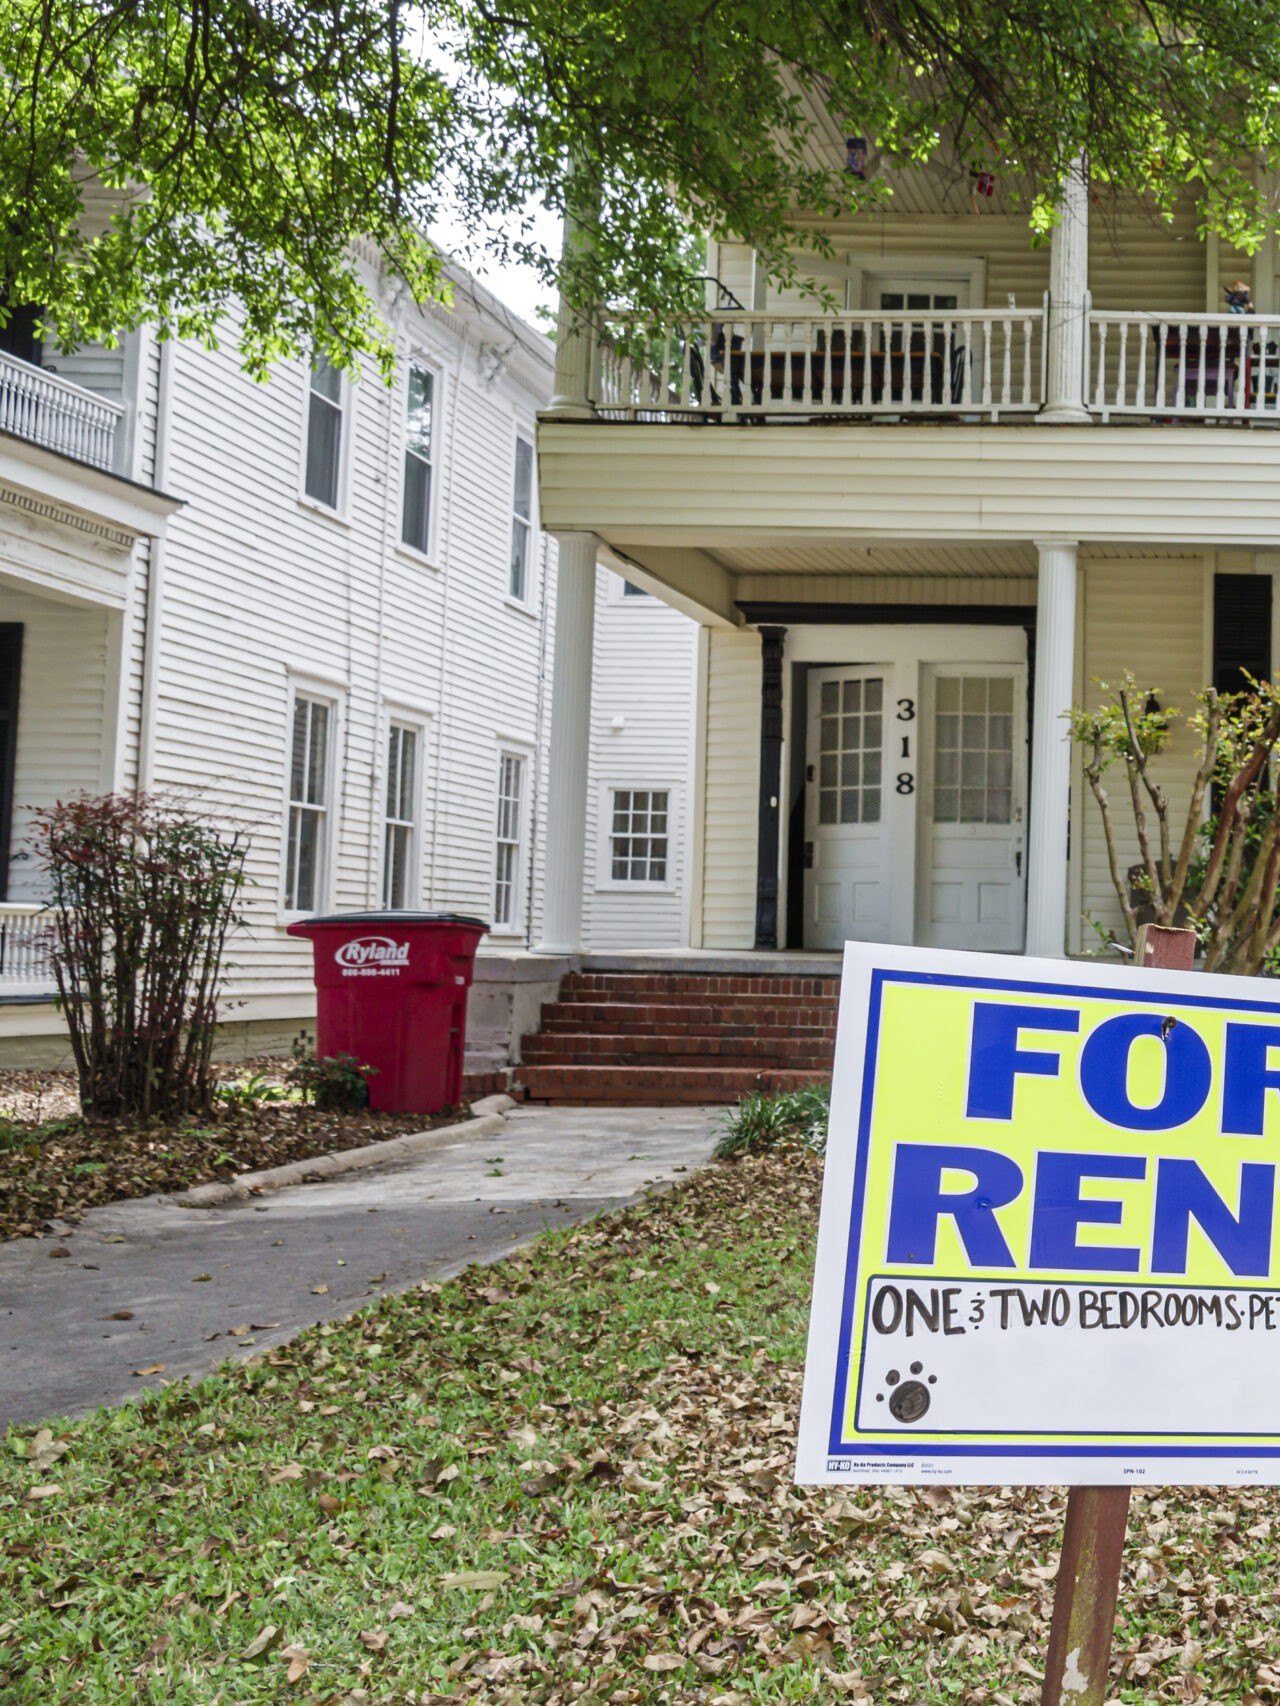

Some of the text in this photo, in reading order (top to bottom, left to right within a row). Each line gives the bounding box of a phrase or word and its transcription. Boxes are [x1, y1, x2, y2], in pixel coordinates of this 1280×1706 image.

[346, 942, 410, 964] Ryland
[872, 1285, 966, 1337] ONE
[989, 1288, 1071, 1330] TWO
[828, 1460, 850, 1471] HY-KO
